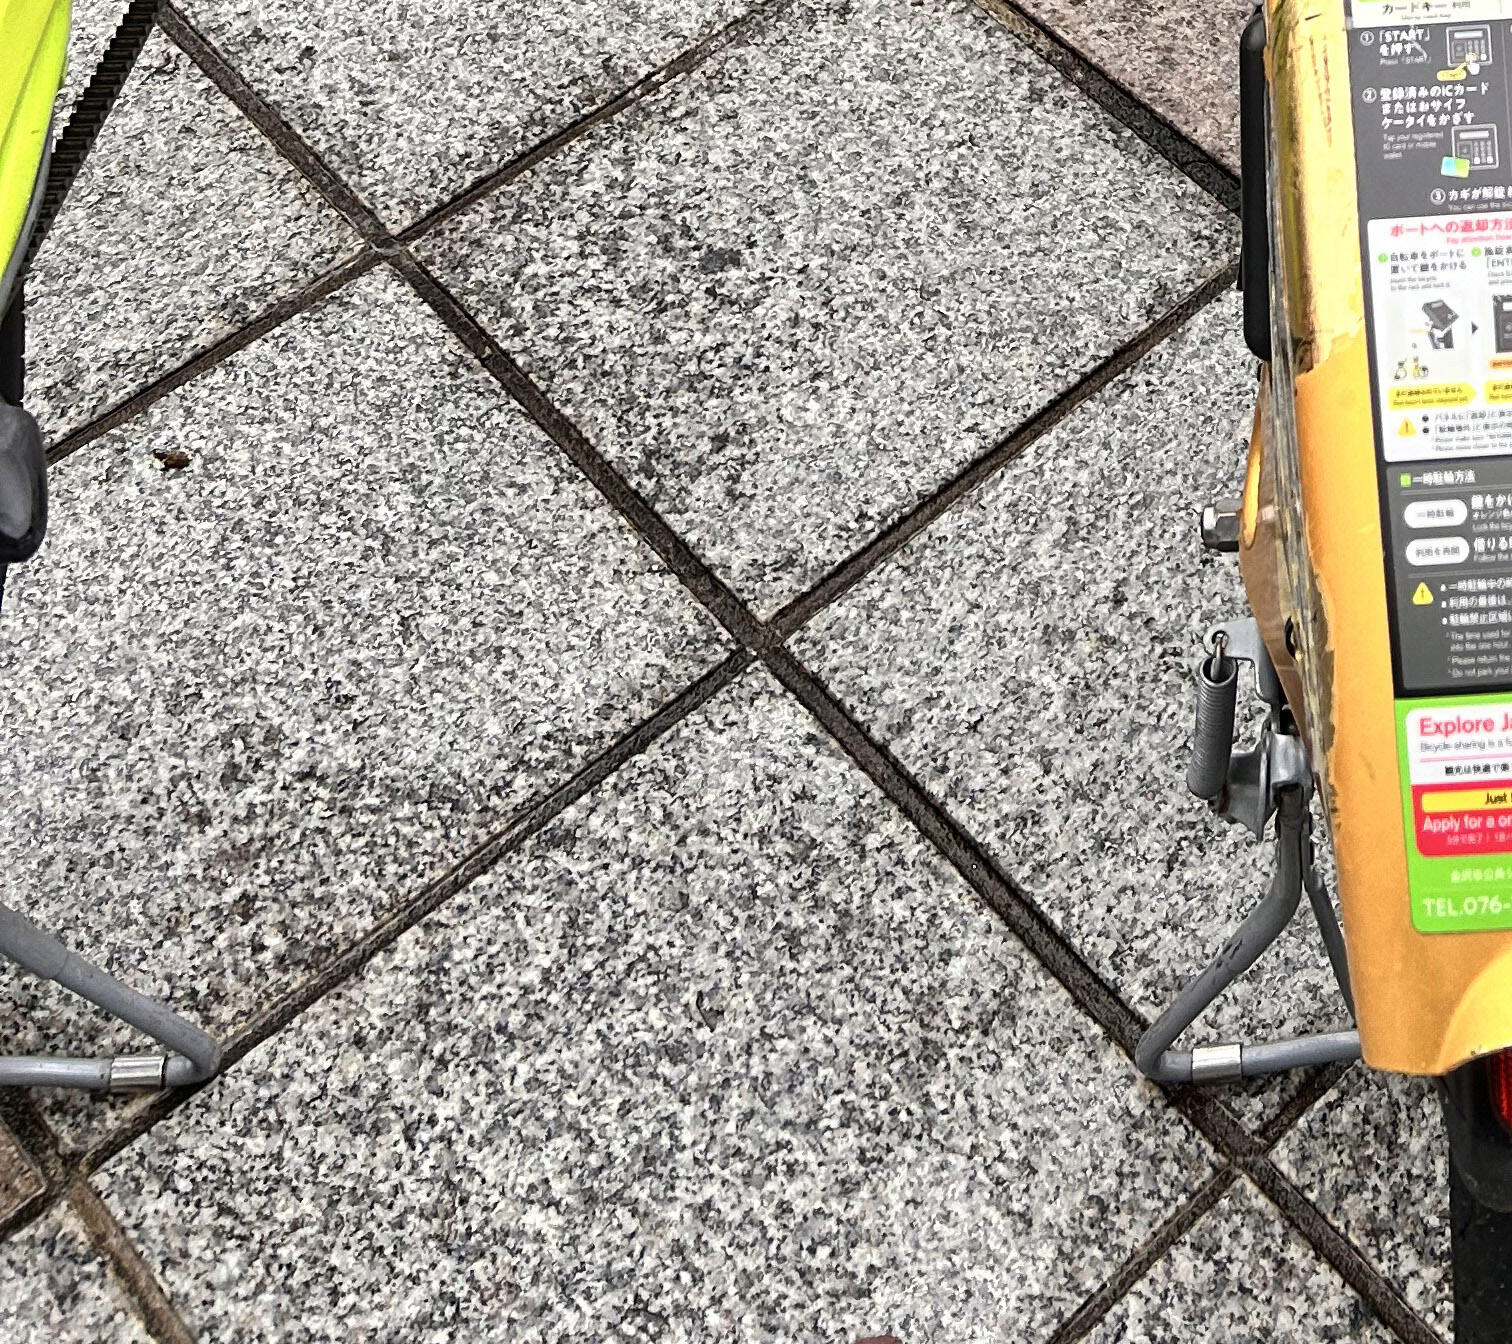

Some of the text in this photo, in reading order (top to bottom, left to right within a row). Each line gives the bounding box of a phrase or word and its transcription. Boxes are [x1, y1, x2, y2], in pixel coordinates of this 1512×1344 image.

[1419, 714, 1495, 740] Explore
[1453, 739, 1486, 752] sharing
[1485, 791, 1508, 805] Just
[1423, 815, 1461, 833] Apply
[1463, 814, 1483, 829] for
[1486, 817, 1495, 828] a
